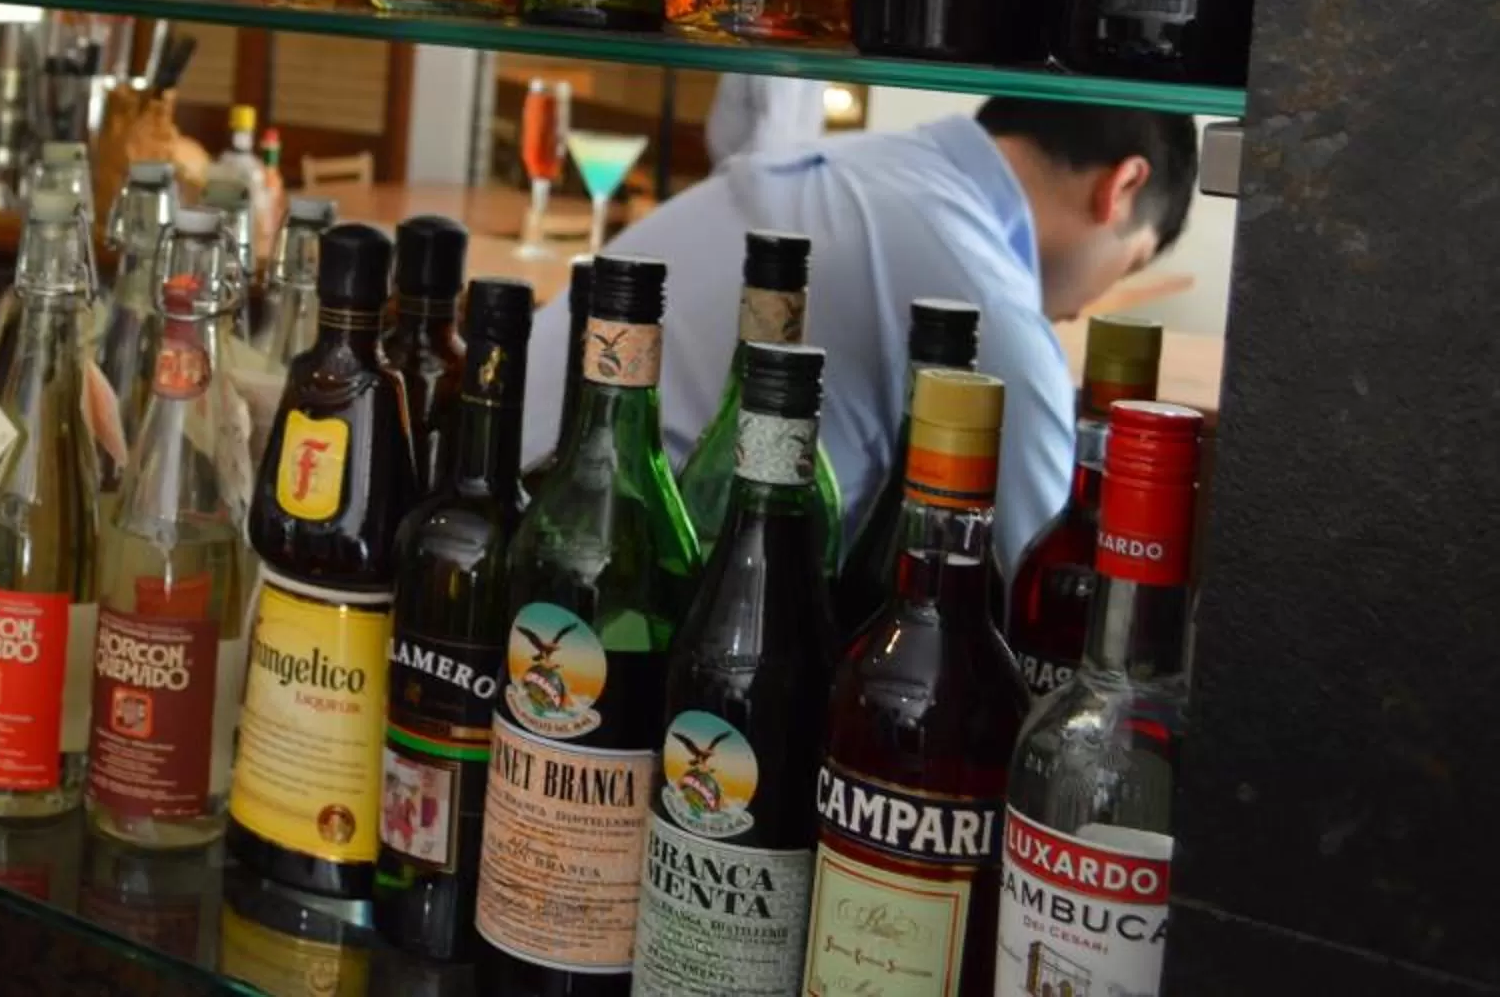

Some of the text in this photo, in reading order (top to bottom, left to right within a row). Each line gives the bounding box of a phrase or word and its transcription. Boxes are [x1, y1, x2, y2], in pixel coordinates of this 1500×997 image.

[543, 759, 636, 808] BRANCA
[816, 765, 996, 856] CAMPARI
[1008, 821, 1161, 895] LUXARDO
